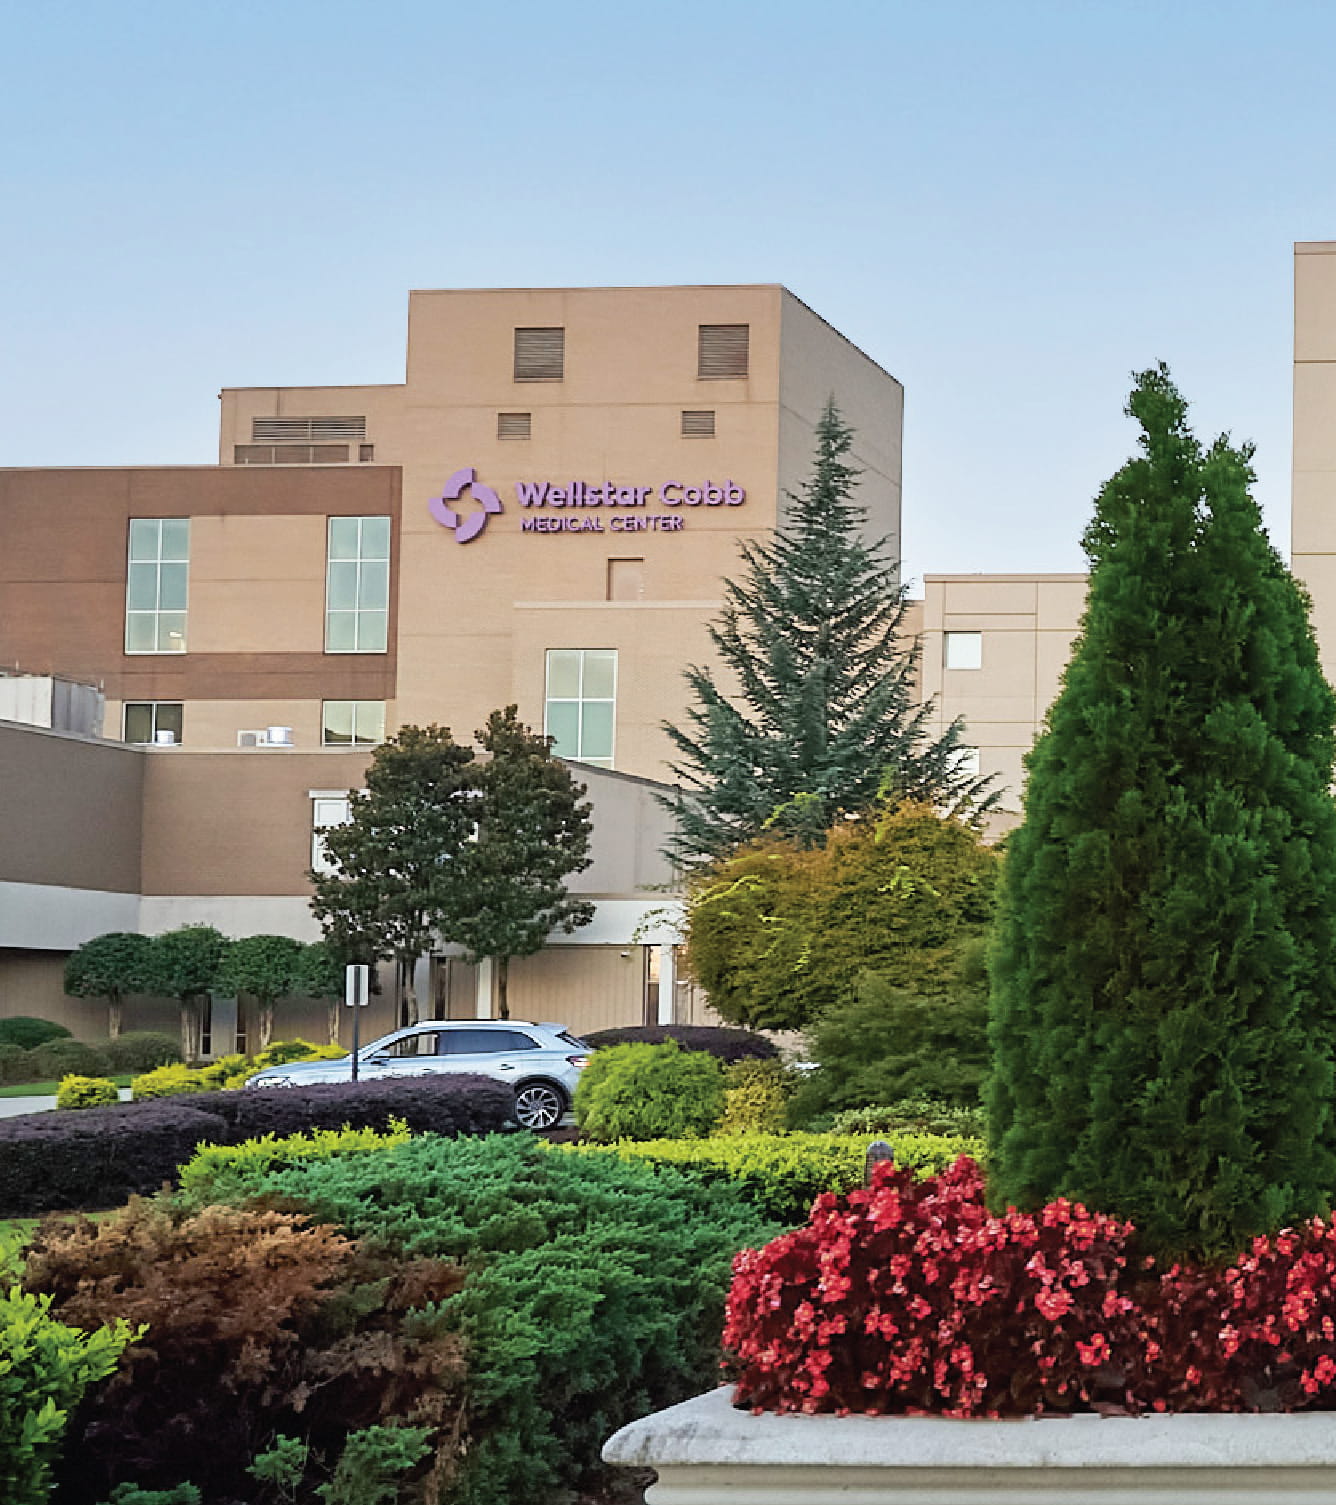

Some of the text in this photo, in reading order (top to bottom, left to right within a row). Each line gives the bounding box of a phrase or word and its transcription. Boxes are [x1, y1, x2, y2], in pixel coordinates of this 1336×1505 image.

[515, 479, 746, 507] Wellstar Cobb
[520, 514, 684, 532] MEDICAL CENTER
